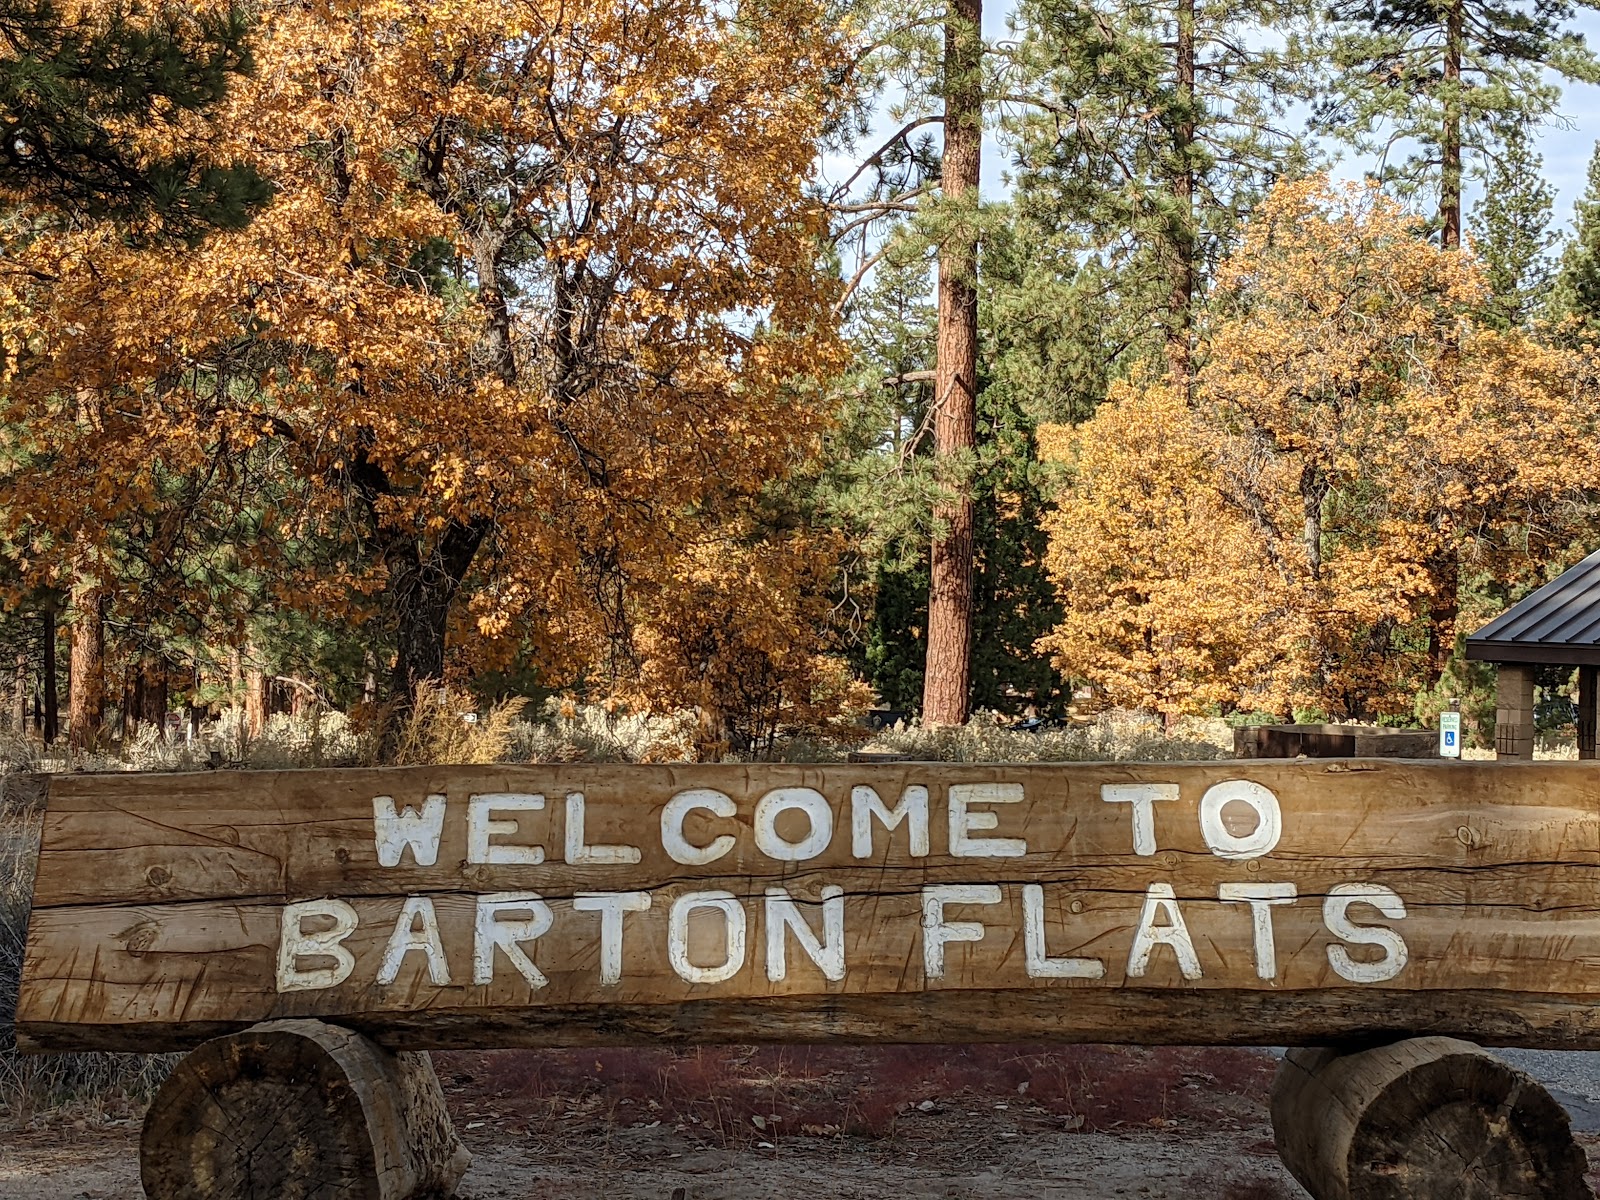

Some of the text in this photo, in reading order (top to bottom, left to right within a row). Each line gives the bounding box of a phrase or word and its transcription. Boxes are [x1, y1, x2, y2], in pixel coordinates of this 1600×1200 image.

[372, 779, 1283, 868] WELCOME TO
[276, 882, 1409, 993] BARTON FLATS
